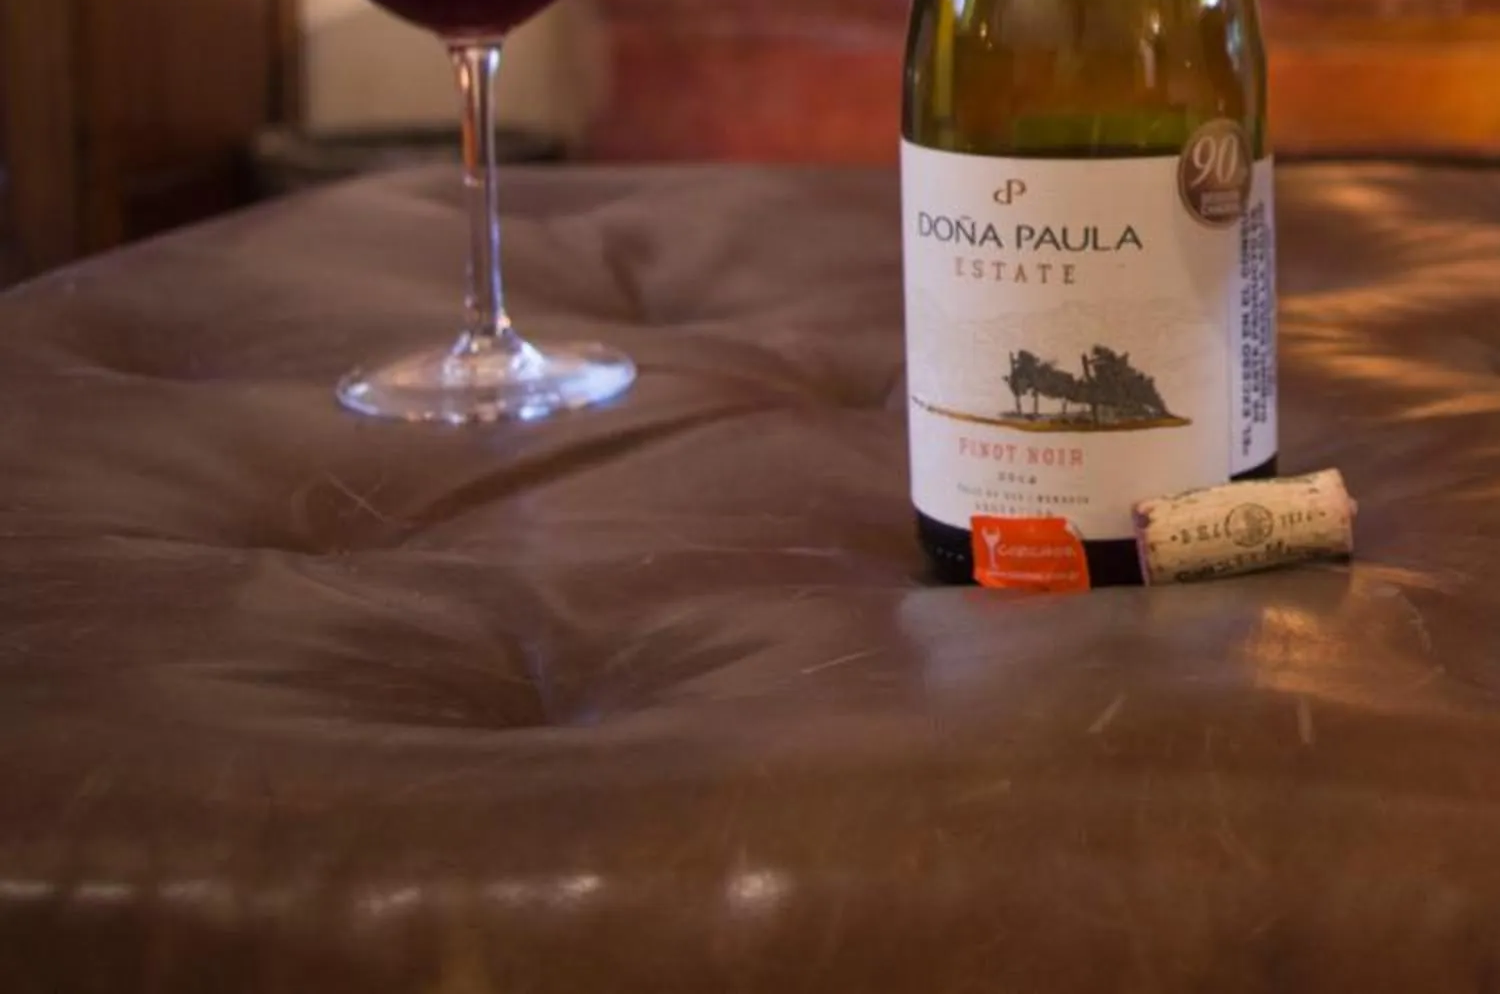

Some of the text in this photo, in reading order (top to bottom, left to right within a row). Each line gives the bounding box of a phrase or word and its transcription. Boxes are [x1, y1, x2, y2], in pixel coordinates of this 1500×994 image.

[1191, 133, 1239, 186] 90
[917, 211, 1144, 252] DOÑA PAULA
[955, 256, 1076, 284] ESTATE
[959, 436, 1084, 466] PINOT NOIR
